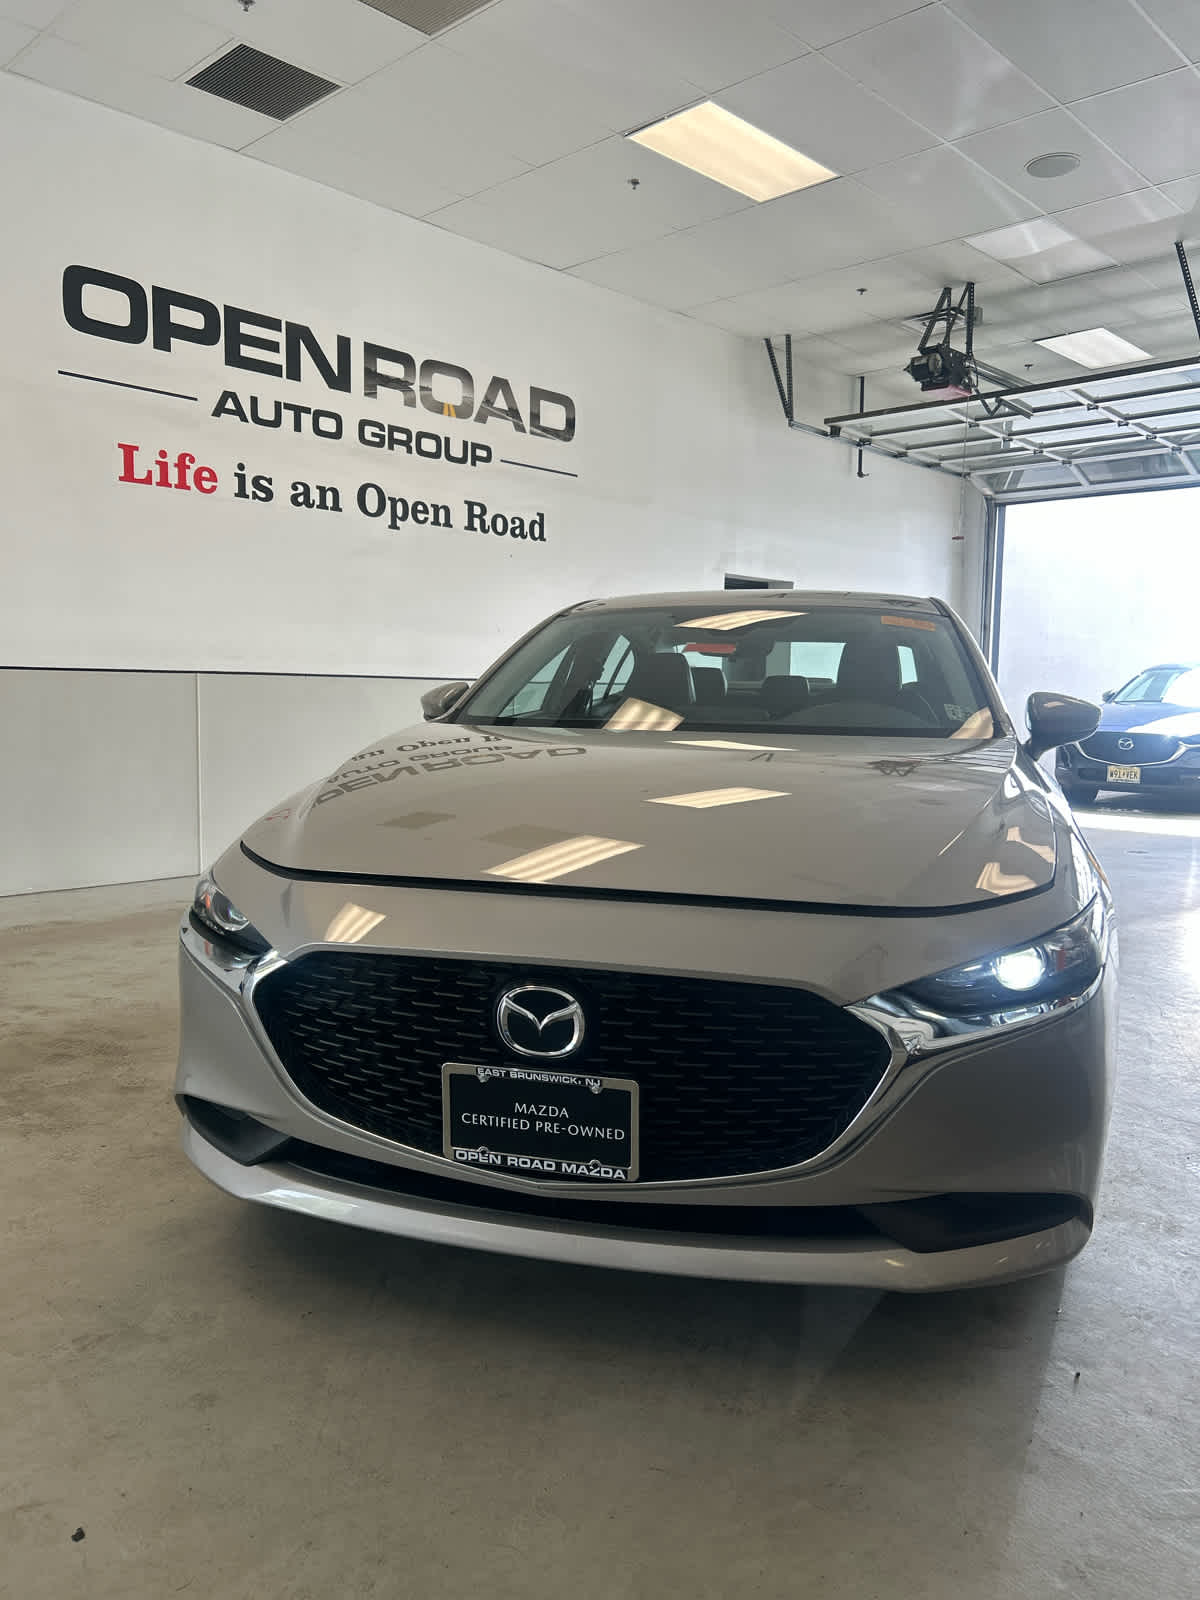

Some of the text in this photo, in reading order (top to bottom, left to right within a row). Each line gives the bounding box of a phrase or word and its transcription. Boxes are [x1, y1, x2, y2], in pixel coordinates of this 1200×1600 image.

[62, 264, 576, 443] OPEN ROAD
[211, 390, 493, 467] AUTO GROUP
[117, 442, 547, 542] Life is an Open Road
[477, 1067, 507, 1077] EAST
[585, 1078, 601, 1088] NJ
[514, 1102, 570, 1119] MAZDA
[461, 1112, 626, 1141] CERTIFIED PRE-OWNED
[455, 1150, 626, 1180] OPEN ROAD MAZDA
